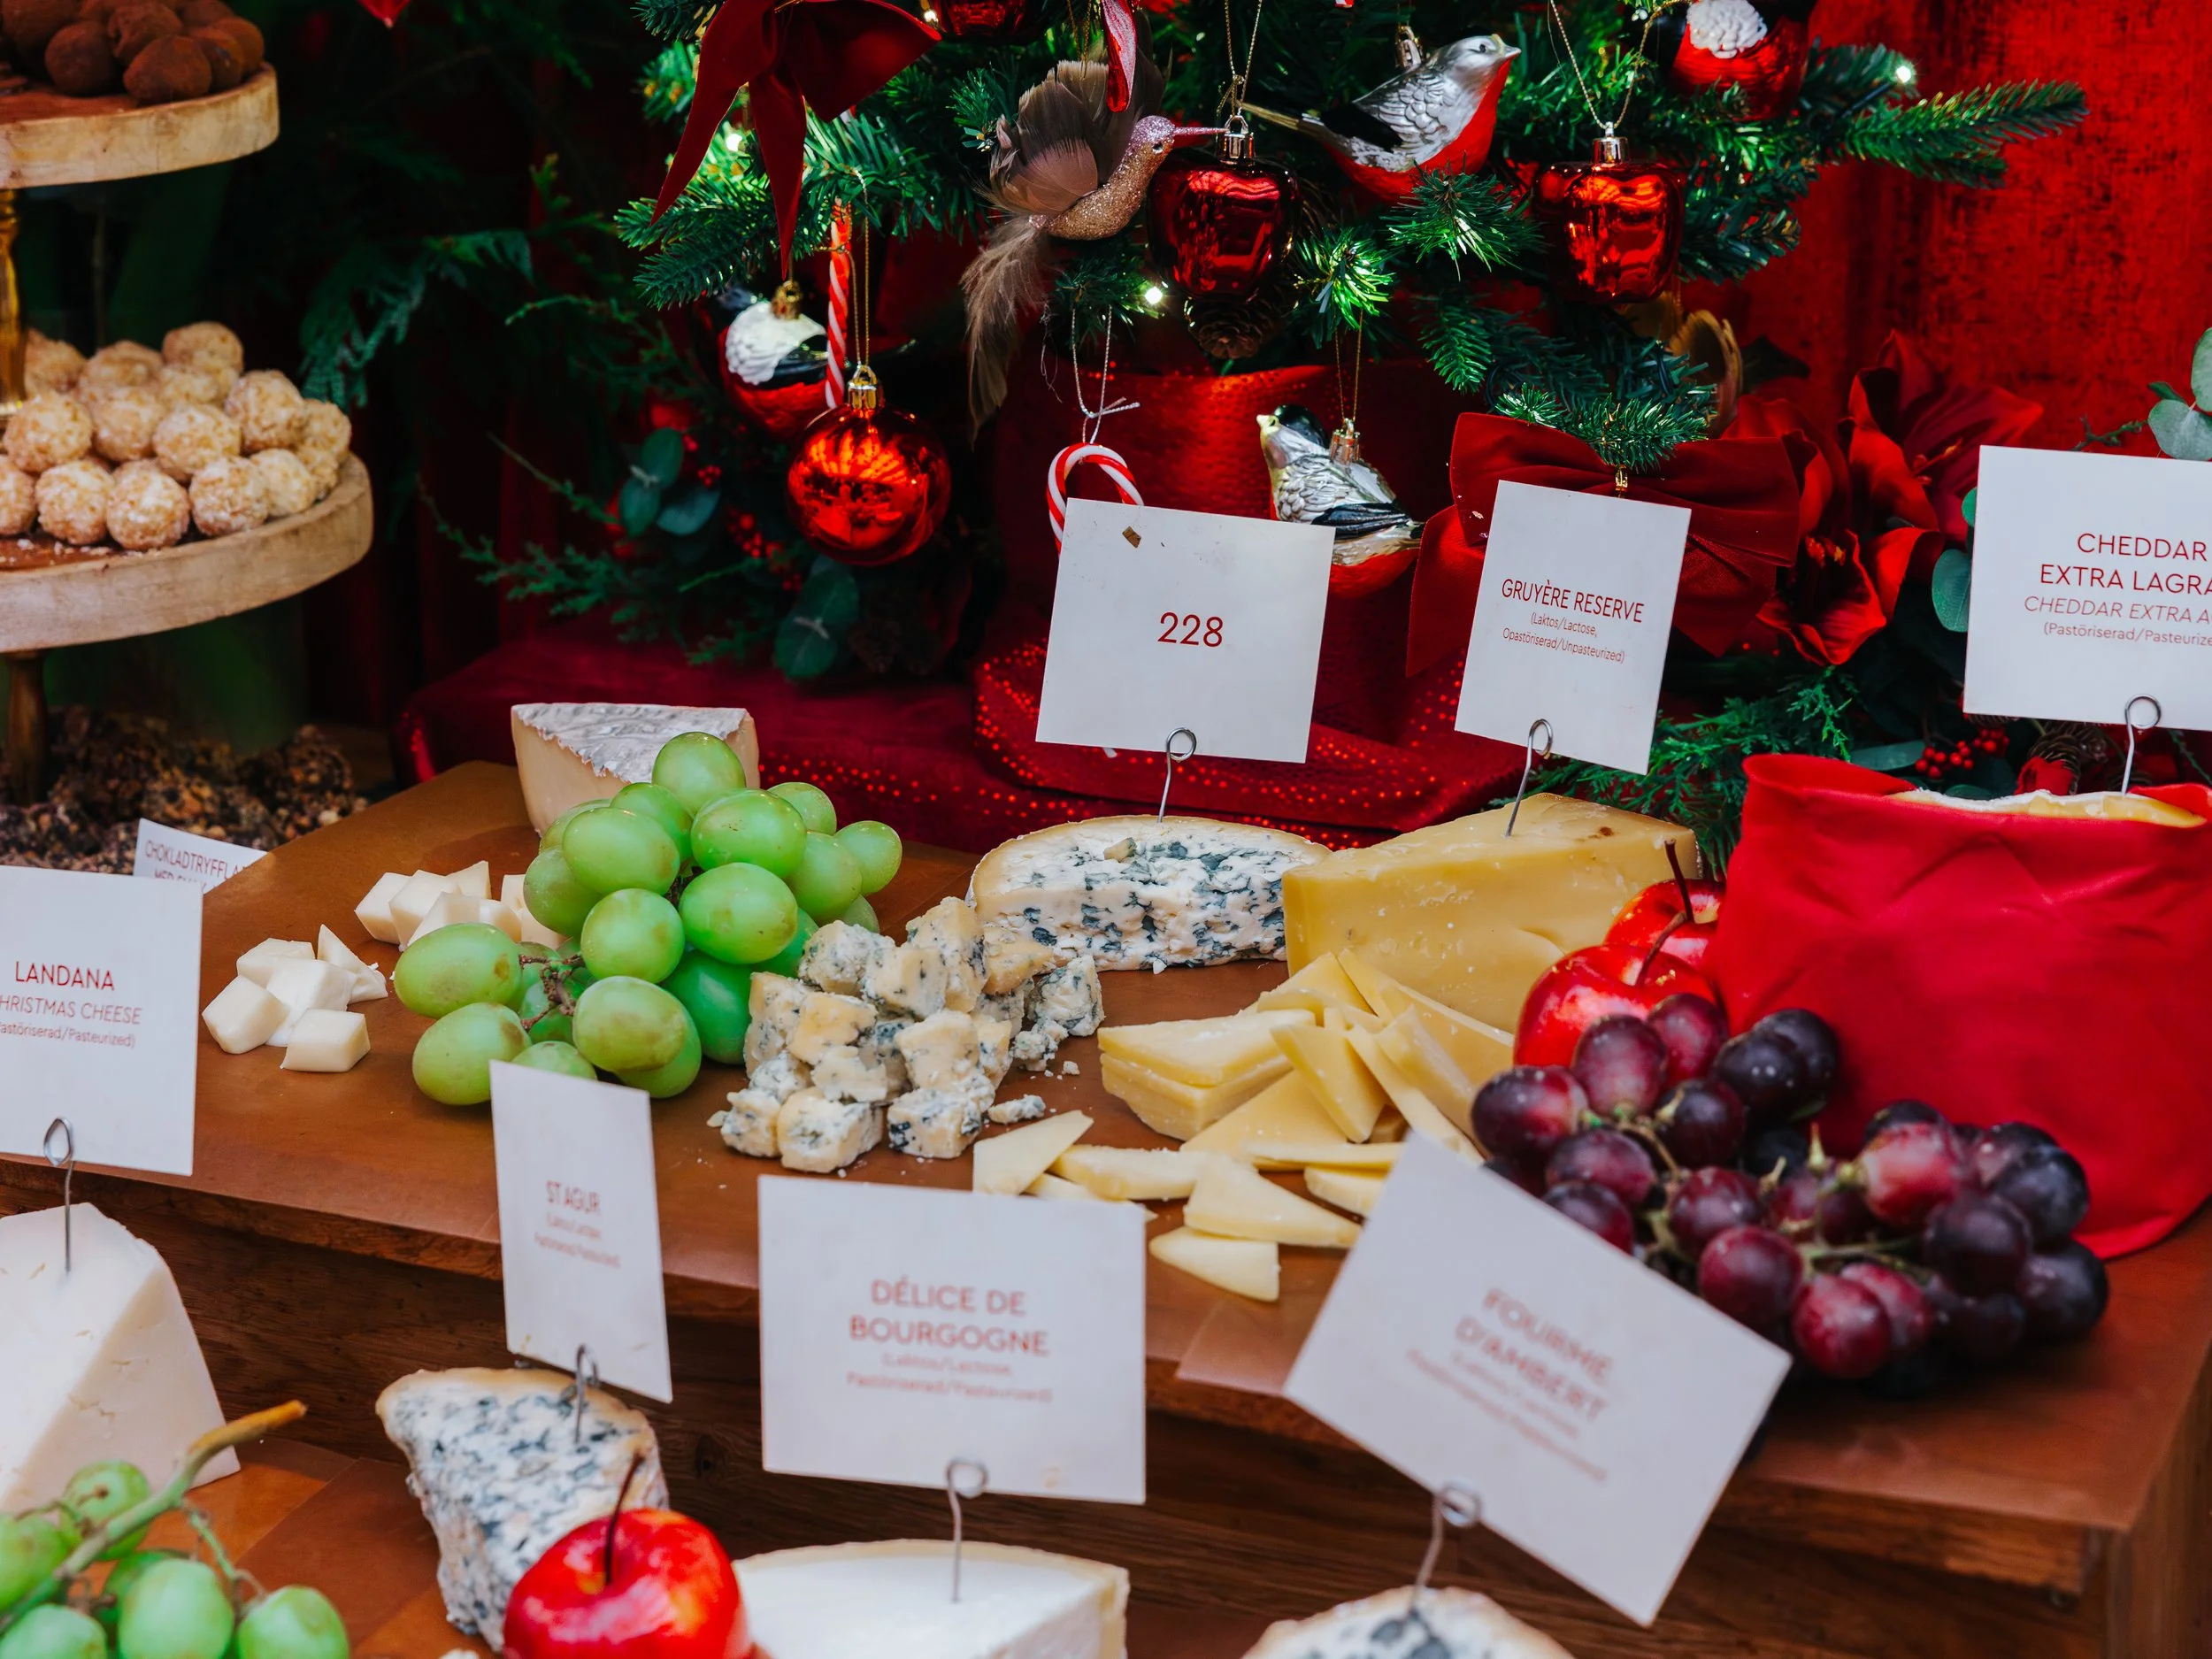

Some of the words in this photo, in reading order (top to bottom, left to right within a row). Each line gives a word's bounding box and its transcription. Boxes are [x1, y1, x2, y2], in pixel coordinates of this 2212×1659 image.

[2077, 533, 2208, 562] CHEDDAR
[2040, 564, 2124, 589] EXTRA
[1501, 579, 1571, 610] GRUYÈRE
[1573, 591, 1645, 623] RESERVE
[2024, 595, 2124, 618] CHEDDAR
[2128, 603, 2192, 624] EXTRA
[2196, 608, 2212, 625] A
[1156, 611, 1224, 648] 228
[1530, 611, 1598, 638] (Laktos/Lactose,
[1502, 627, 1625, 664] Opastöriserad/Unpasteurized)
[15, 960, 116, 992] LANDANA
[80, 1002, 143, 1025] CHEESE
[0, 1021, 136, 1049] astöriserad/Pasteurized)
[871, 1275, 978, 1314] DÉLICE
[986, 1288, 1027, 1317] DE
[849, 1313, 1050, 1357] BOURGOGNE
